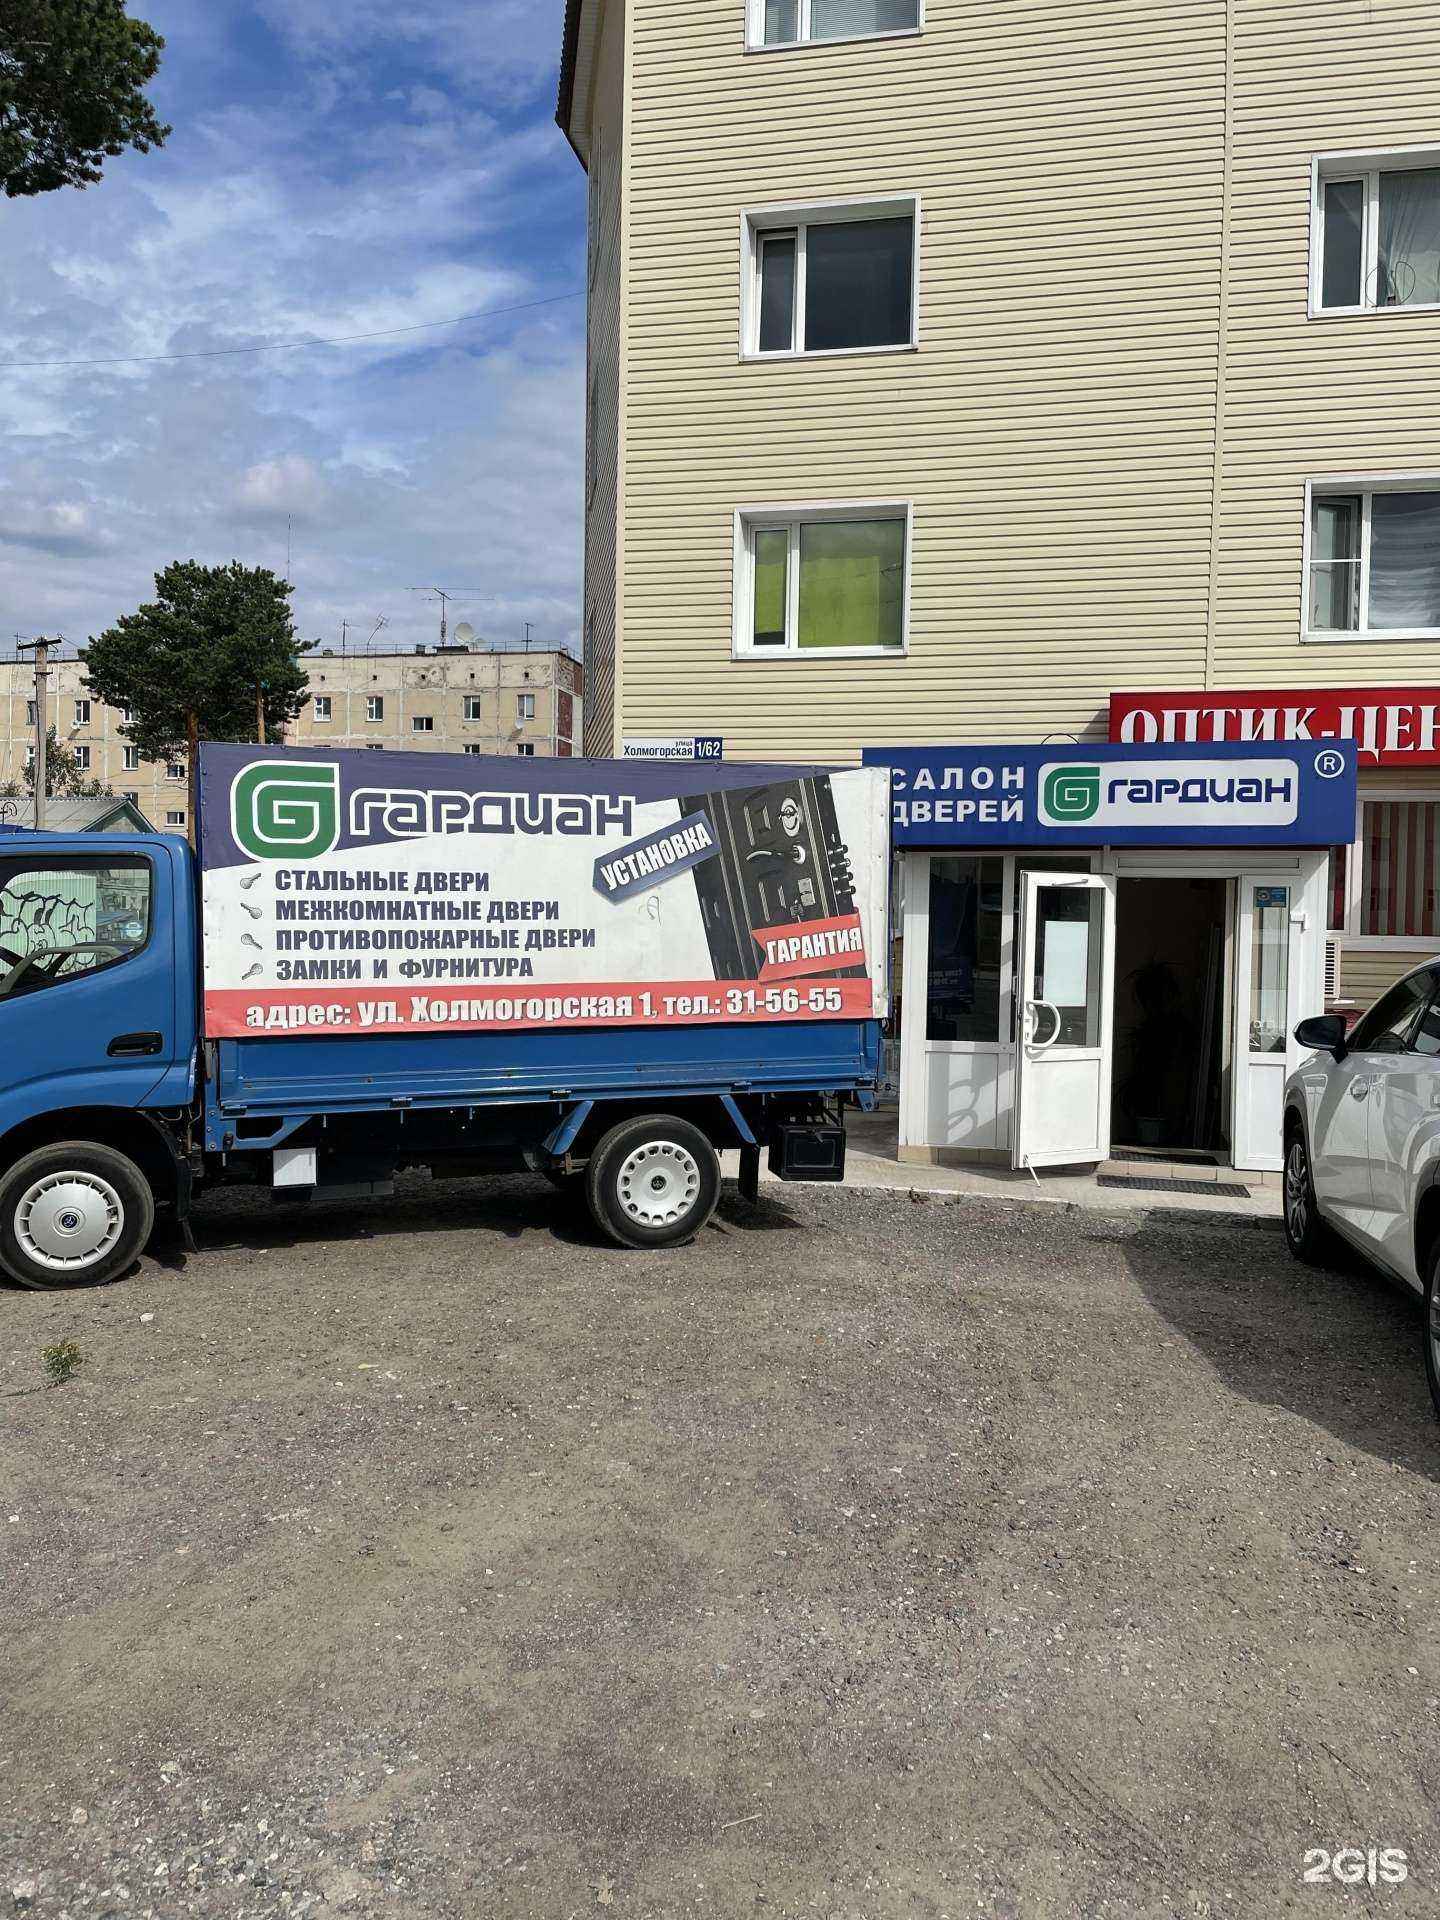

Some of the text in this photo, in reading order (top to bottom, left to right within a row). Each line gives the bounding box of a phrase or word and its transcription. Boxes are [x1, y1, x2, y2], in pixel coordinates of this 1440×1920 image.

[624, 741, 720, 757] Холмогорская 1/62
[892, 766, 1024, 790] САЛОН
[894, 794, 1024, 828] ДВЕРЕЙ
[600, 822, 713, 891] УСТАНОВКА
[275, 869, 489, 894] СТАЛЬНЫЕ ДВЕРИ
[276, 899, 560, 923] МЕЖКОМНАТНЫЕ ДВЕРИ
[276, 928, 596, 951] ПРОТИВОПОЖАРНЫЕ ДВЕРИ
[766, 926, 863, 965] ГАРАНТИЯ
[276, 956, 534, 981] ЗАМКИ И ФУРНИТУРА
[246, 986, 843, 1028] адрес: ул. Холмогорская 1, тел.: 31-56-55
